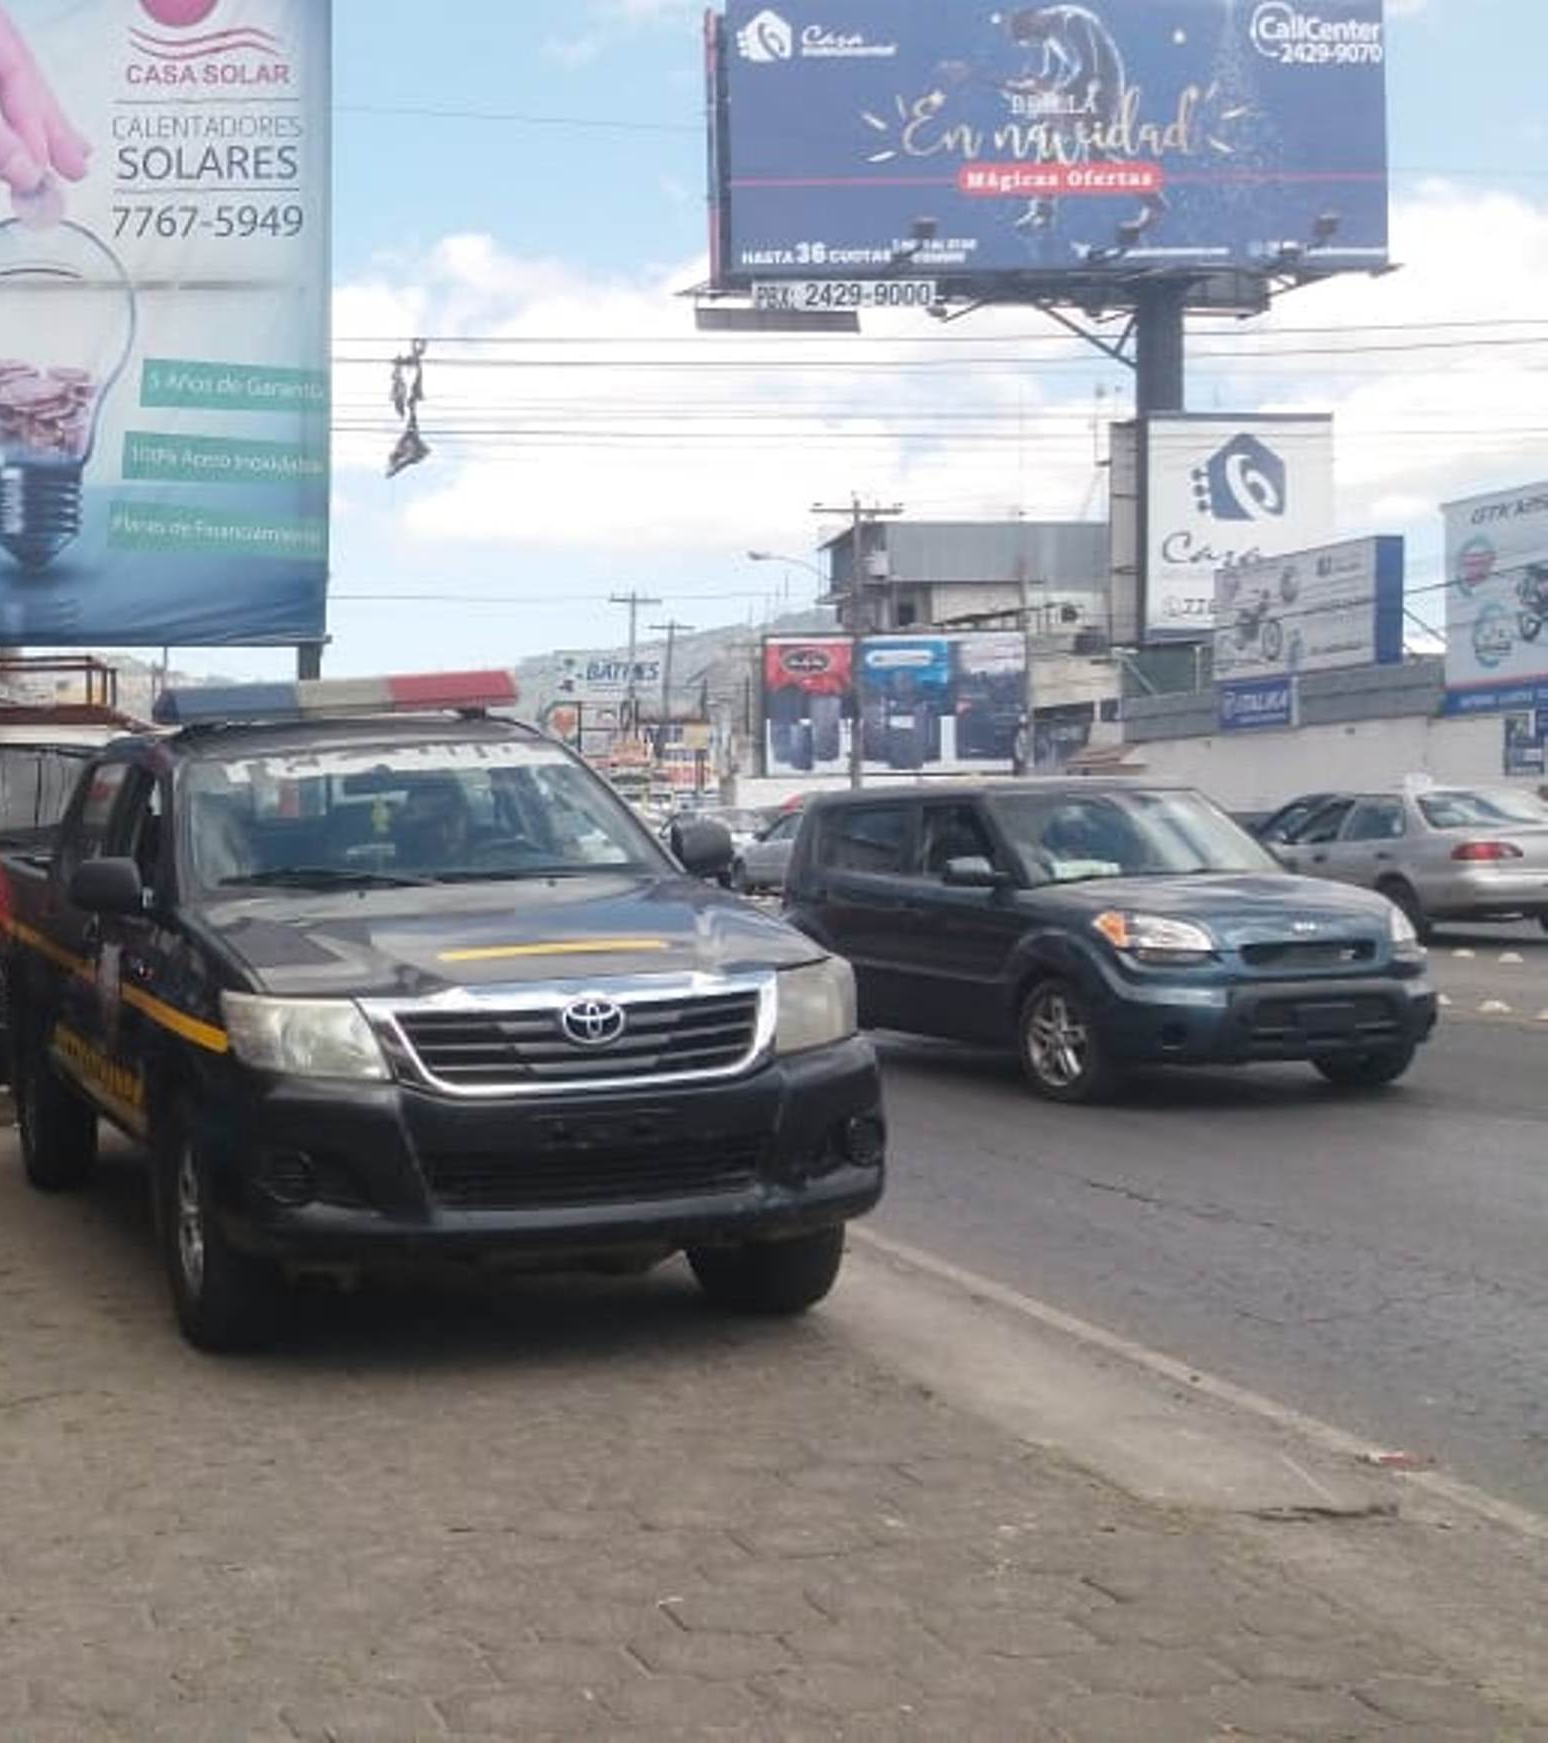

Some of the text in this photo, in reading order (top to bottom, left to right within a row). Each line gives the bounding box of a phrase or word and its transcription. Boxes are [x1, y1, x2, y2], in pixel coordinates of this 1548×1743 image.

[1258, 15, 1381, 42] CallCenter
[1279, 43, 1383, 64] 2429-9070
[126, 63, 290, 85] CASA SOLAR
[111, 115, 302, 139] CALENTADORES
[116, 145, 298, 181] SOLARES
[1066, 170, 1153, 189] Ofertas
[111, 204, 303, 239] 7767-5949
[742, 251, 794, 265] HASTA
[795, 242, 827, 265] 36
[804, 283, 932, 307] 2429-9000
